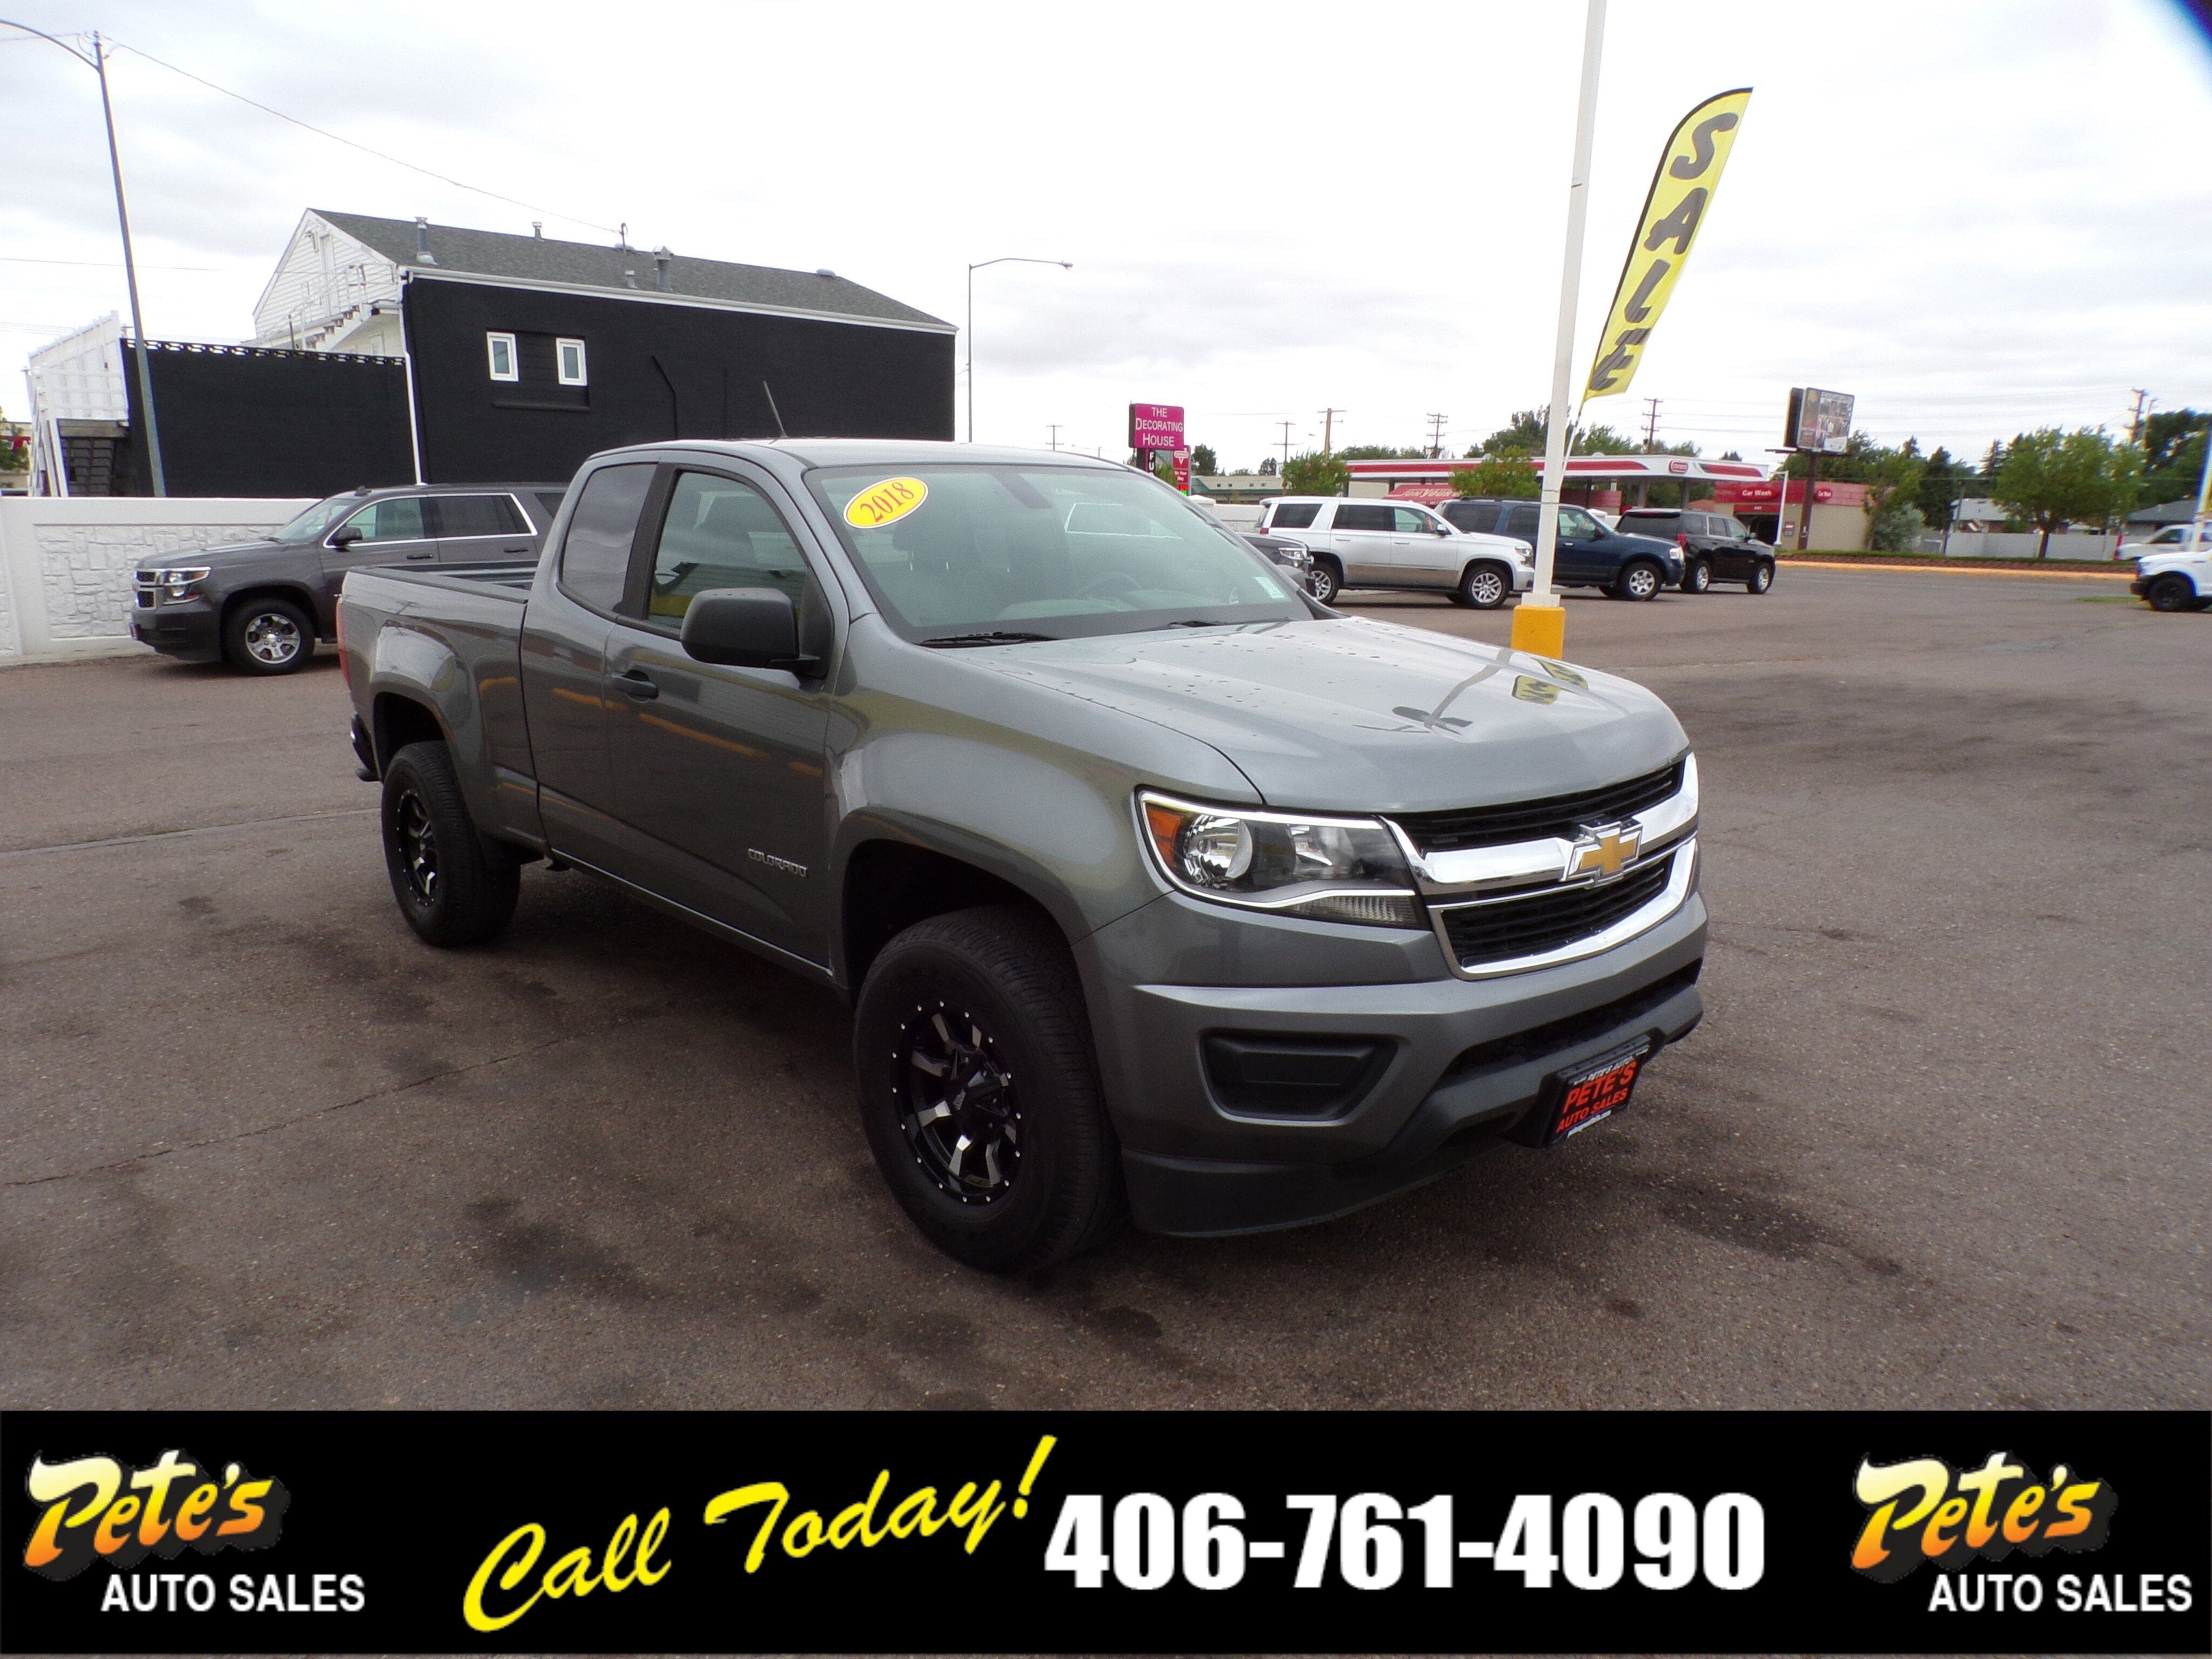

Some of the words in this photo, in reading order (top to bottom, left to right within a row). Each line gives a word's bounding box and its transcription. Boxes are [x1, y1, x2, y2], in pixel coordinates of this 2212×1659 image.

[1589, 112, 1739, 391] SALE
[1135, 417, 1183, 432] DECORATING
[1151, 407, 1168, 418] THE
[1142, 433, 1175, 447] HOUSE
[860, 482, 914, 523] 2018
[1563, 1060, 1637, 1114] PETE'S
[1556, 1107, 1590, 1134] AUTO
[1590, 1087, 1629, 1114] SALES
